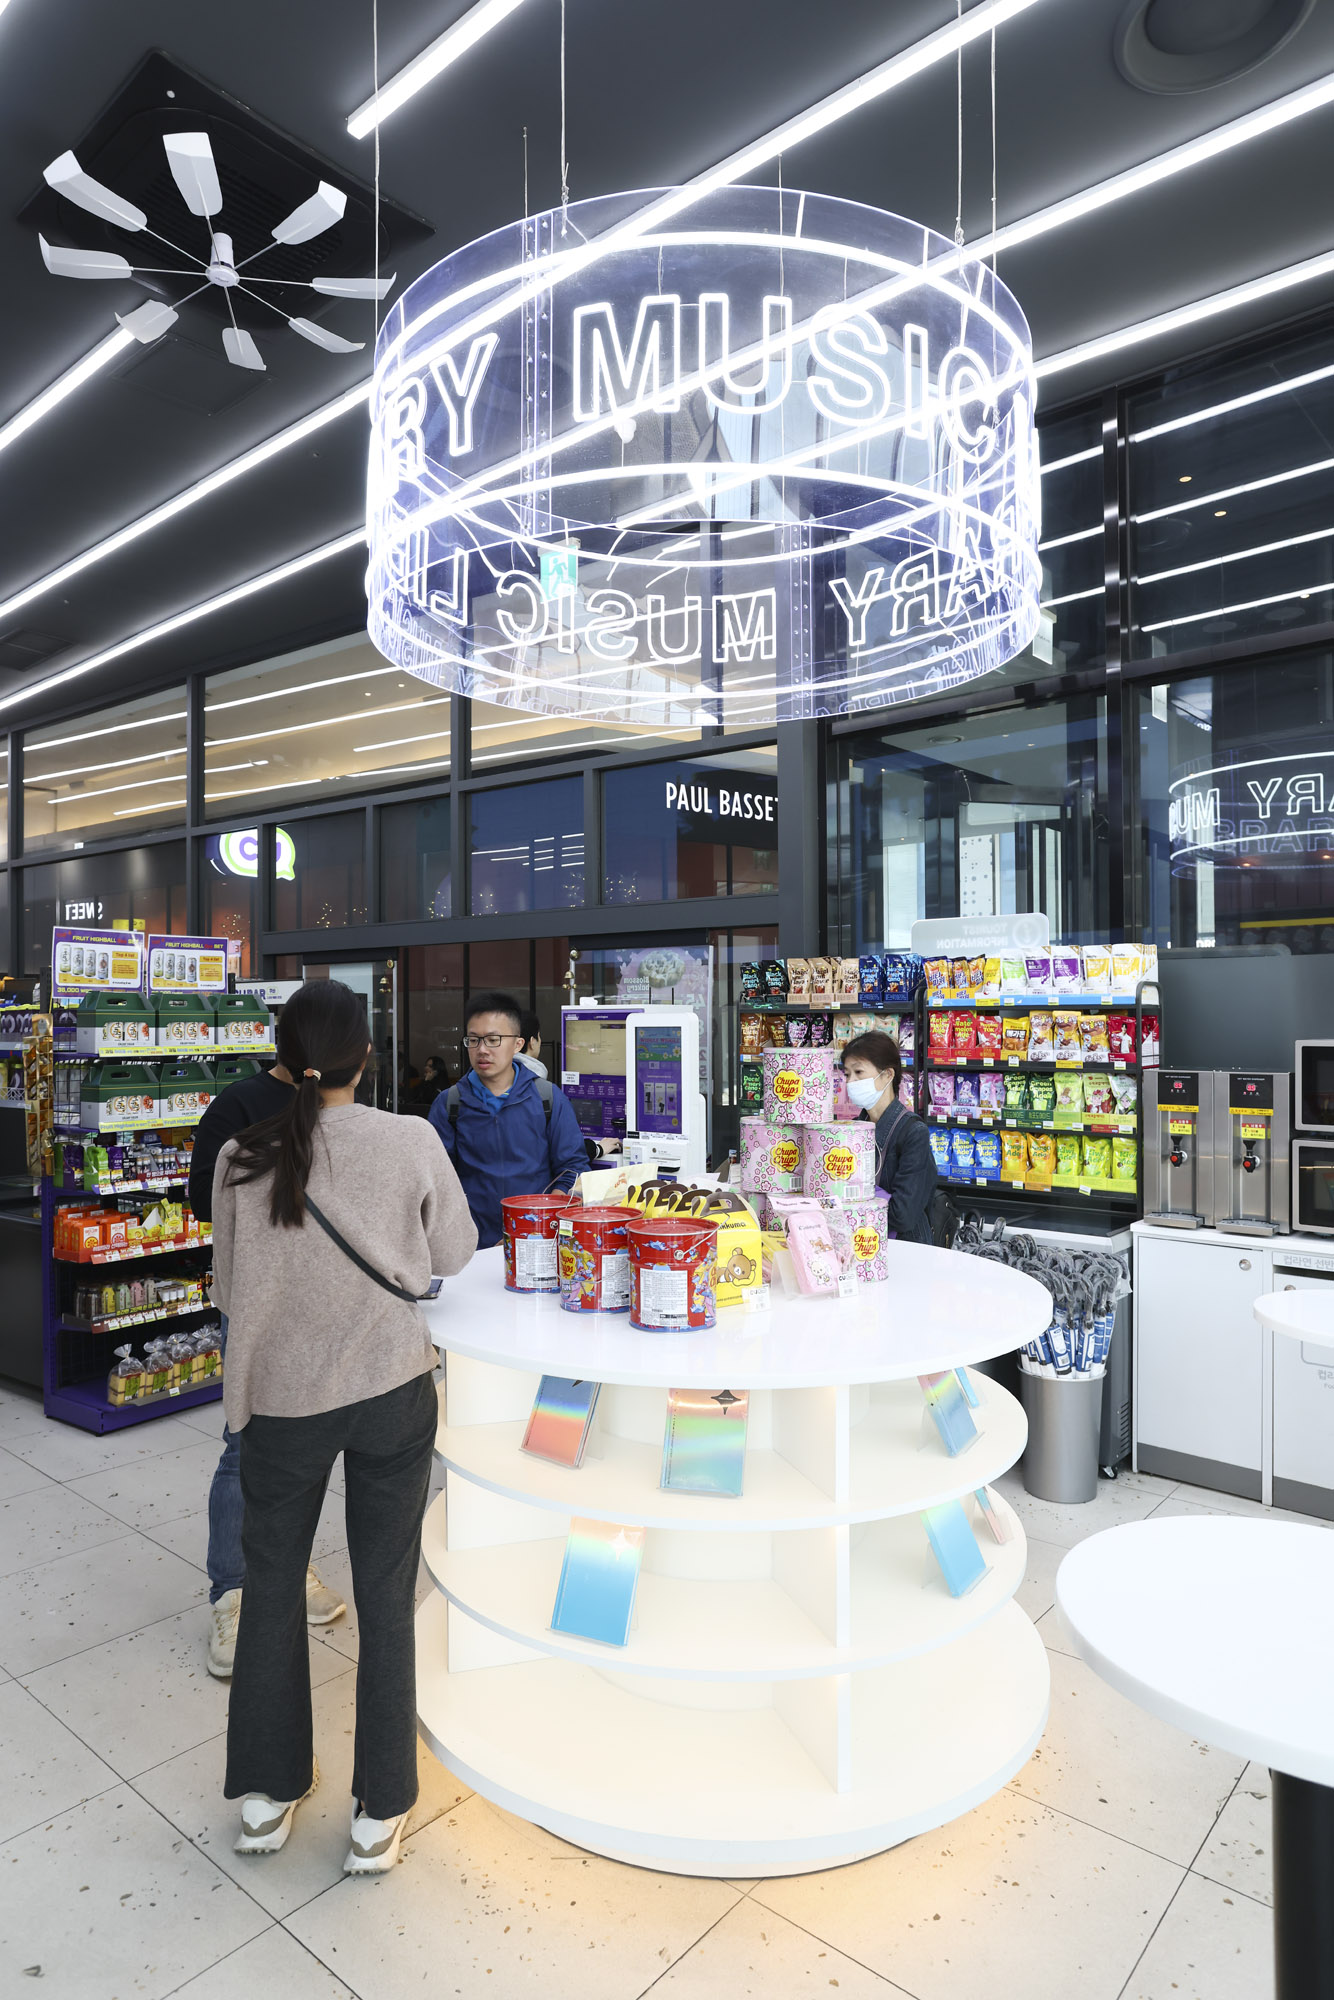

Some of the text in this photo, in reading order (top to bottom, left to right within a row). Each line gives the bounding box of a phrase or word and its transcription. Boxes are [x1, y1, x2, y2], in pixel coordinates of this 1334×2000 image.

[573, 293, 996, 464] MUSIC
[666, 782, 778, 821] PAUL BASSE
[776, 1076, 800, 1086] Chupa
[775, 1084, 799, 1098] Chups
[775, 1147, 797, 1156] Chupa
[827, 1154, 853, 1163] Chupa
[773, 1156, 797, 1168] Chups
[826, 1162, 852, 1176] Chups
[854, 1234, 878, 1243] Chupa
[854, 1242, 878, 1257] Chups
[1283, 1254, 1312, 1268] 컵라면
